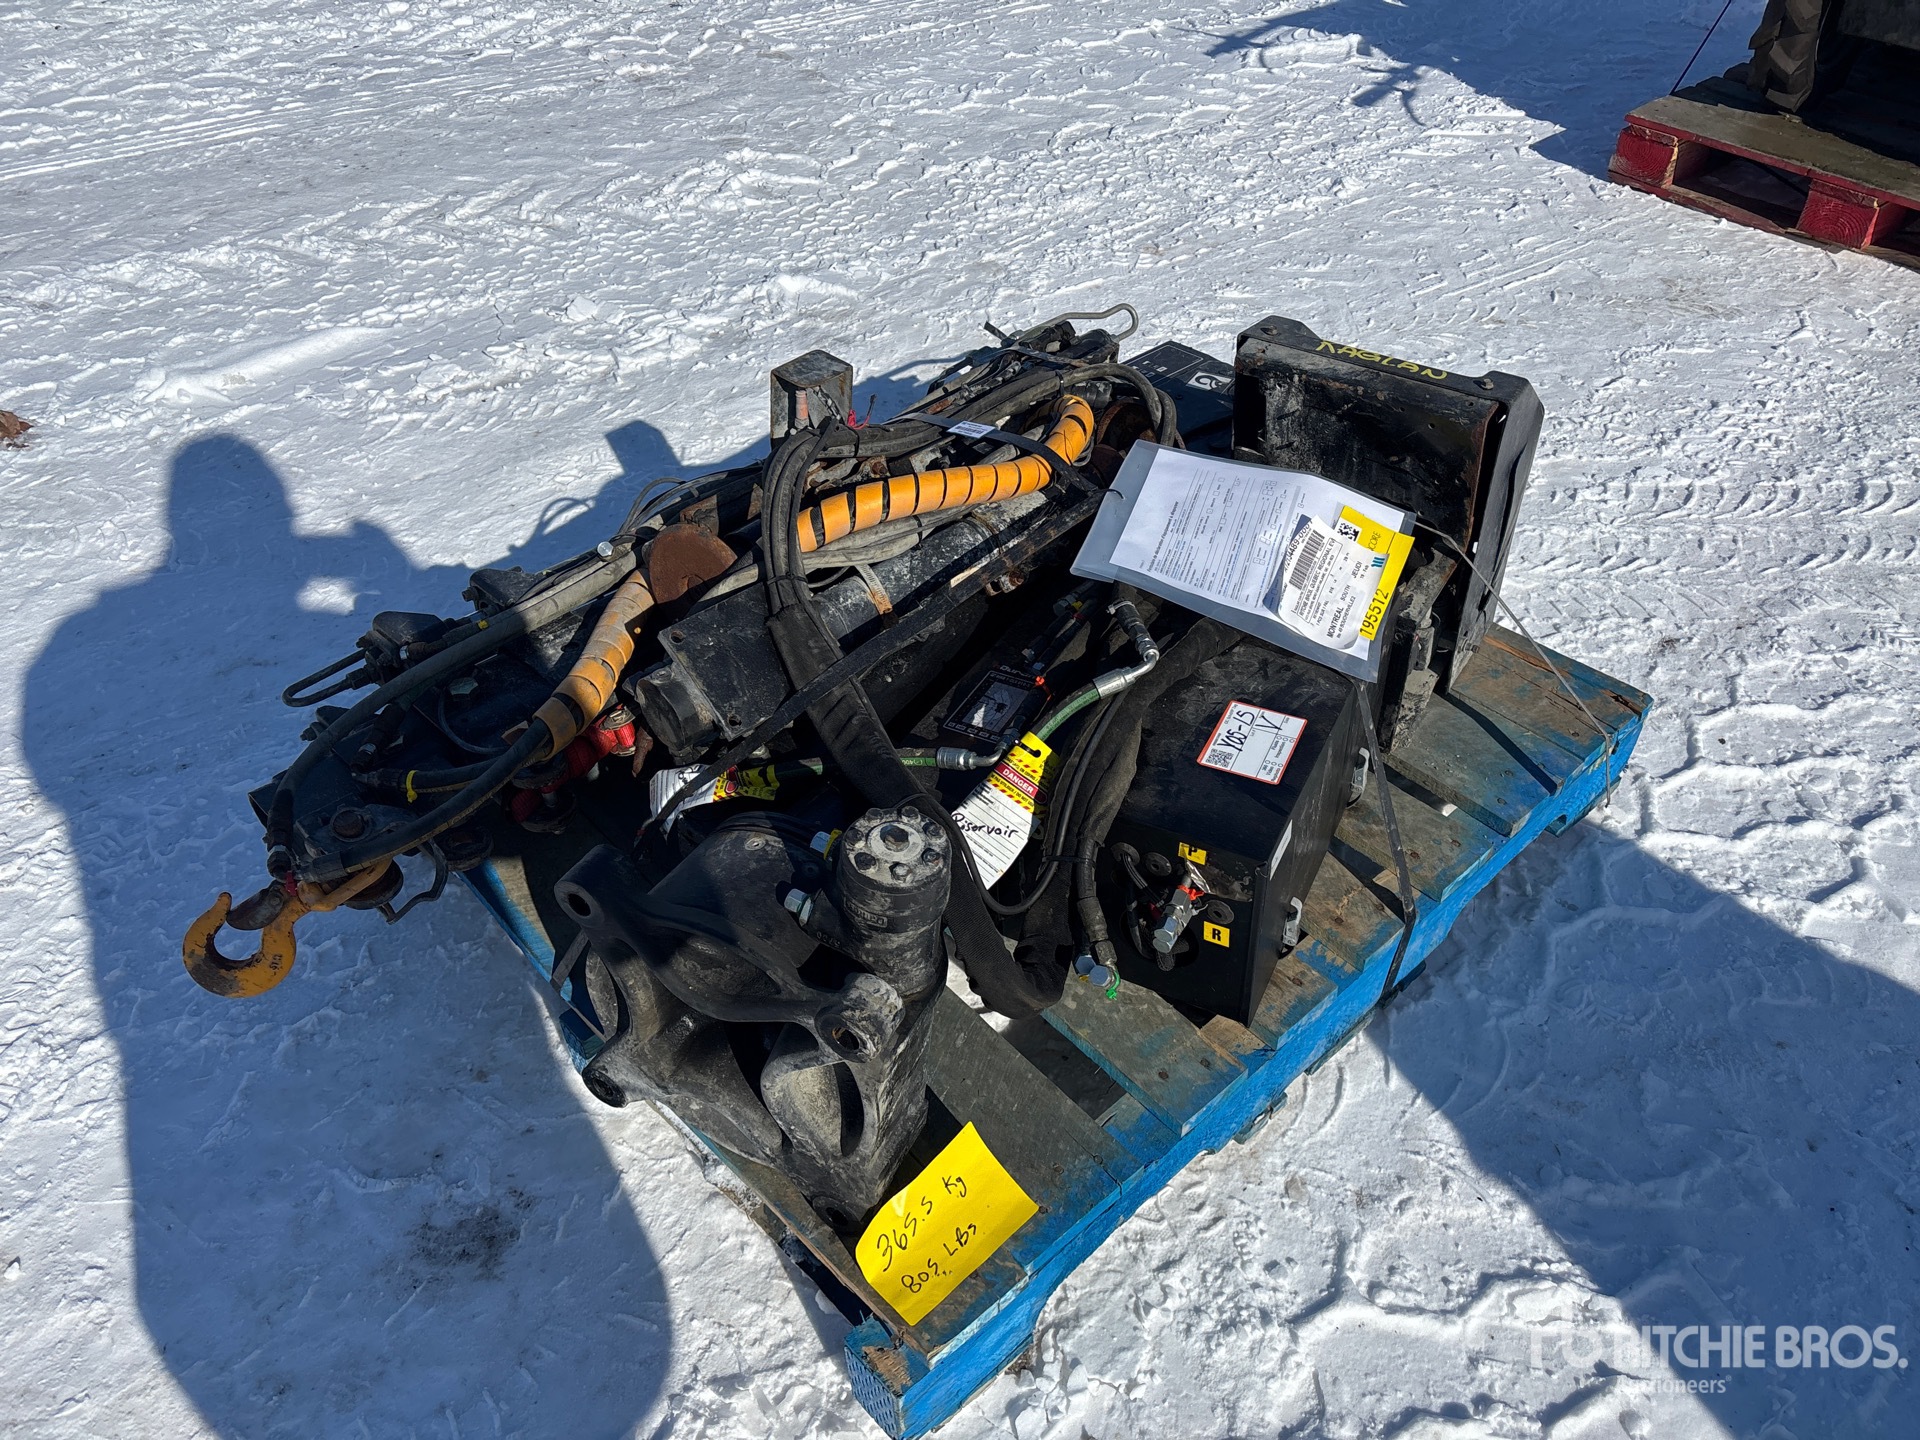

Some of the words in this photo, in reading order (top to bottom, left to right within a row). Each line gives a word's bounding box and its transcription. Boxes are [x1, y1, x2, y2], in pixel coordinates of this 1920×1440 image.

[1316, 341, 1447, 379] RAGLAN
[1297, 600, 1308, 616] RITCHIE
[1311, 570, 1321, 588] QUEBEC
[1319, 547, 1331, 570] REGIONAL
[1327, 607, 1344, 637] MONTREAL
[1341, 584, 1351, 601] SOUTH
[1351, 561, 1362, 578] JEUDI
[1360, 588, 1389, 636] 195512
[1254, 714, 1282, 730] V
[1274, 741, 1286, 758] Inspection
[999, 780, 1015, 793] UTILISER
[1020, 795, 1028, 803] NOT
[1002, 769, 1034, 793] DANGER
[1211, 927, 1222, 943] R
[876, 1195, 933, 1272] 365.5
